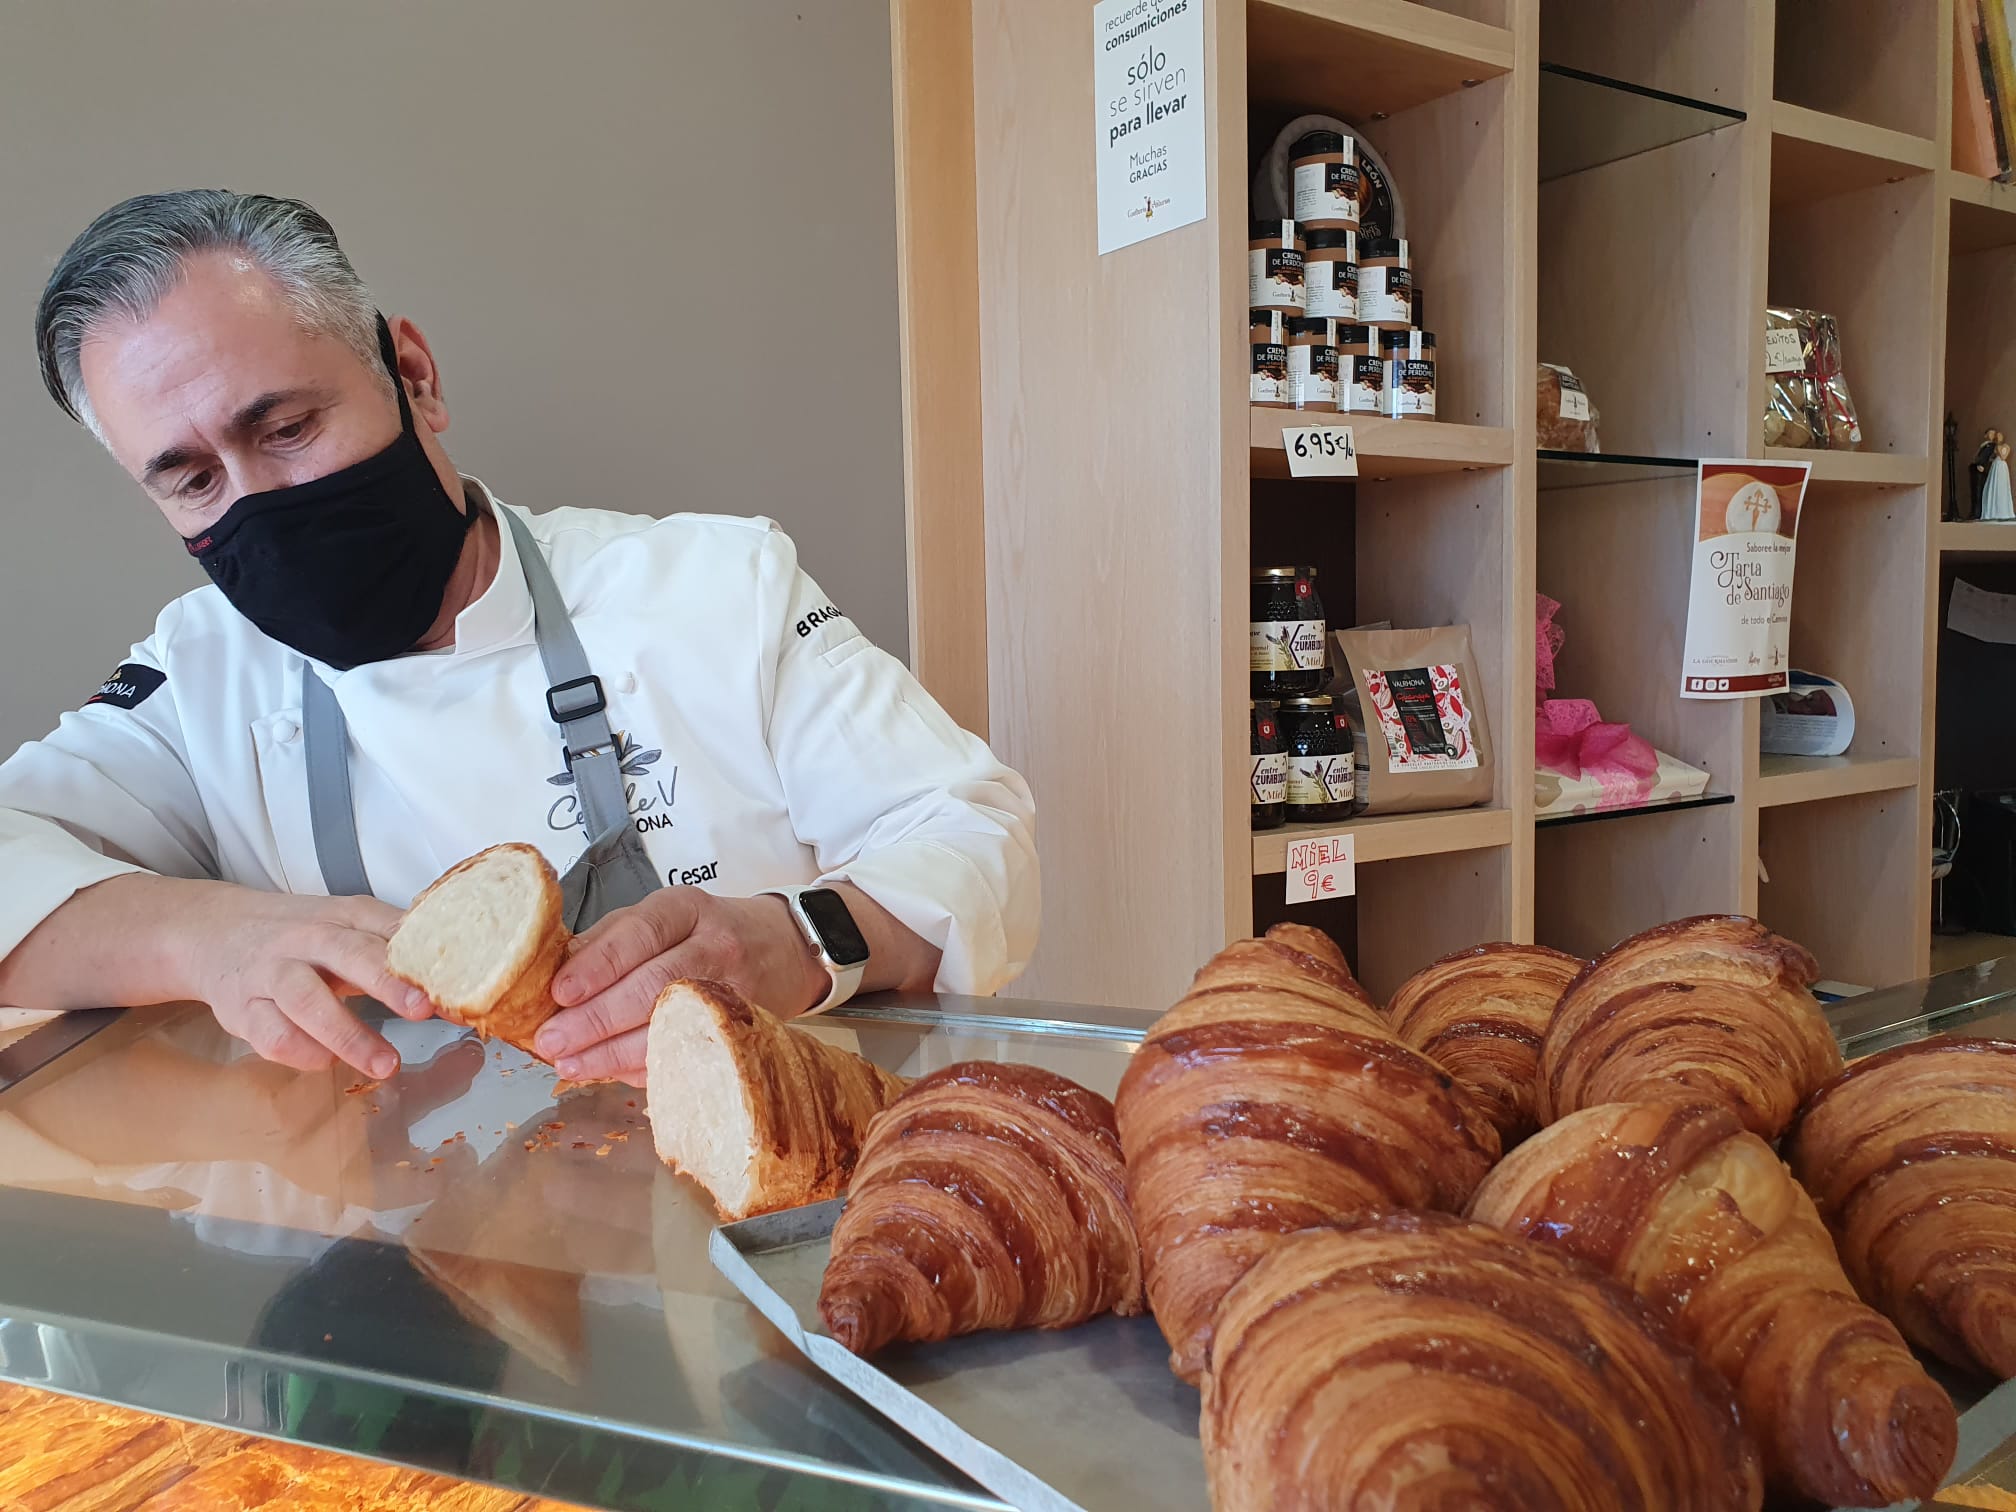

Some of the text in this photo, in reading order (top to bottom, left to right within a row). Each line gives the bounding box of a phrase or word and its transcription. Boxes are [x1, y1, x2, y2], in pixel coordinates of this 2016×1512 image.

[1105, 0, 1148, 32] recuerde
[1105, 0, 1188, 52] consumiciones
[1127, 45, 1166, 85] sólo
[1109, 67, 1186, 118] se sirven
[1109, 93, 1187, 148] para llevar
[1129, 144, 1167, 169] Muchas
[1129, 159, 1168, 184] GRACIAS
[1747, 542, 1772, 552] Saboree
[1710, 551, 1762, 589] Tarta
[1726, 577, 1790, 608] de Santiago
[1741, 616, 1749, 625] de
[1750, 615, 1765, 625] todo
[1300, 633, 1317, 641] entre
[1391, 679, 1425, 688] VALRHONA
[668, 861, 718, 887] Cesar
[1303, 870, 1337, 900] 9€
